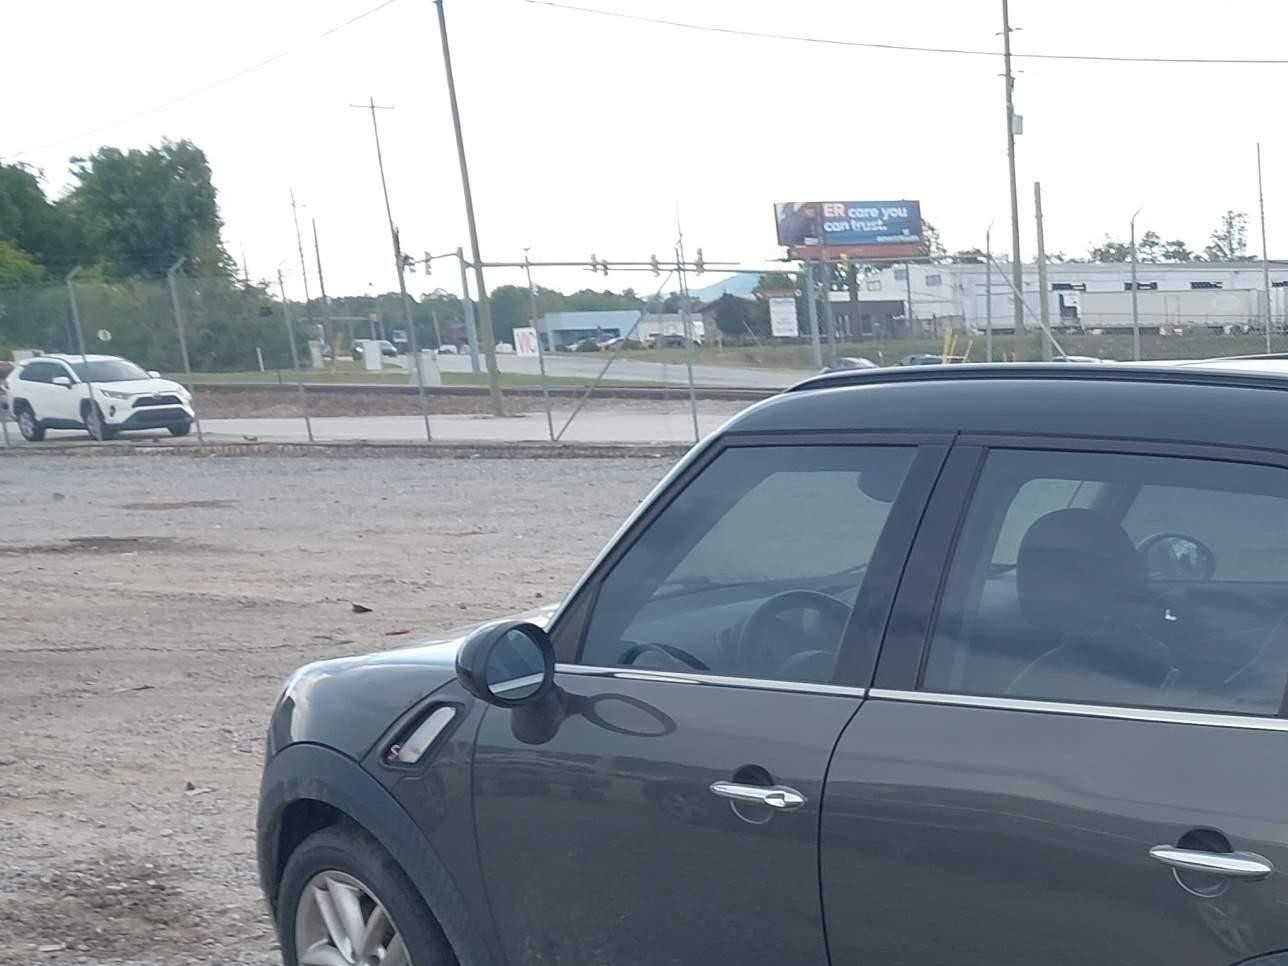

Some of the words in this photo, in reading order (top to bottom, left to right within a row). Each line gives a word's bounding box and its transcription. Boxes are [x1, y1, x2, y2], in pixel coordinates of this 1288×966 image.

[823, 203, 845, 217] ER
[848, 207, 878, 218] care
[881, 207, 908, 220] you
[824, 221, 849, 232] can
